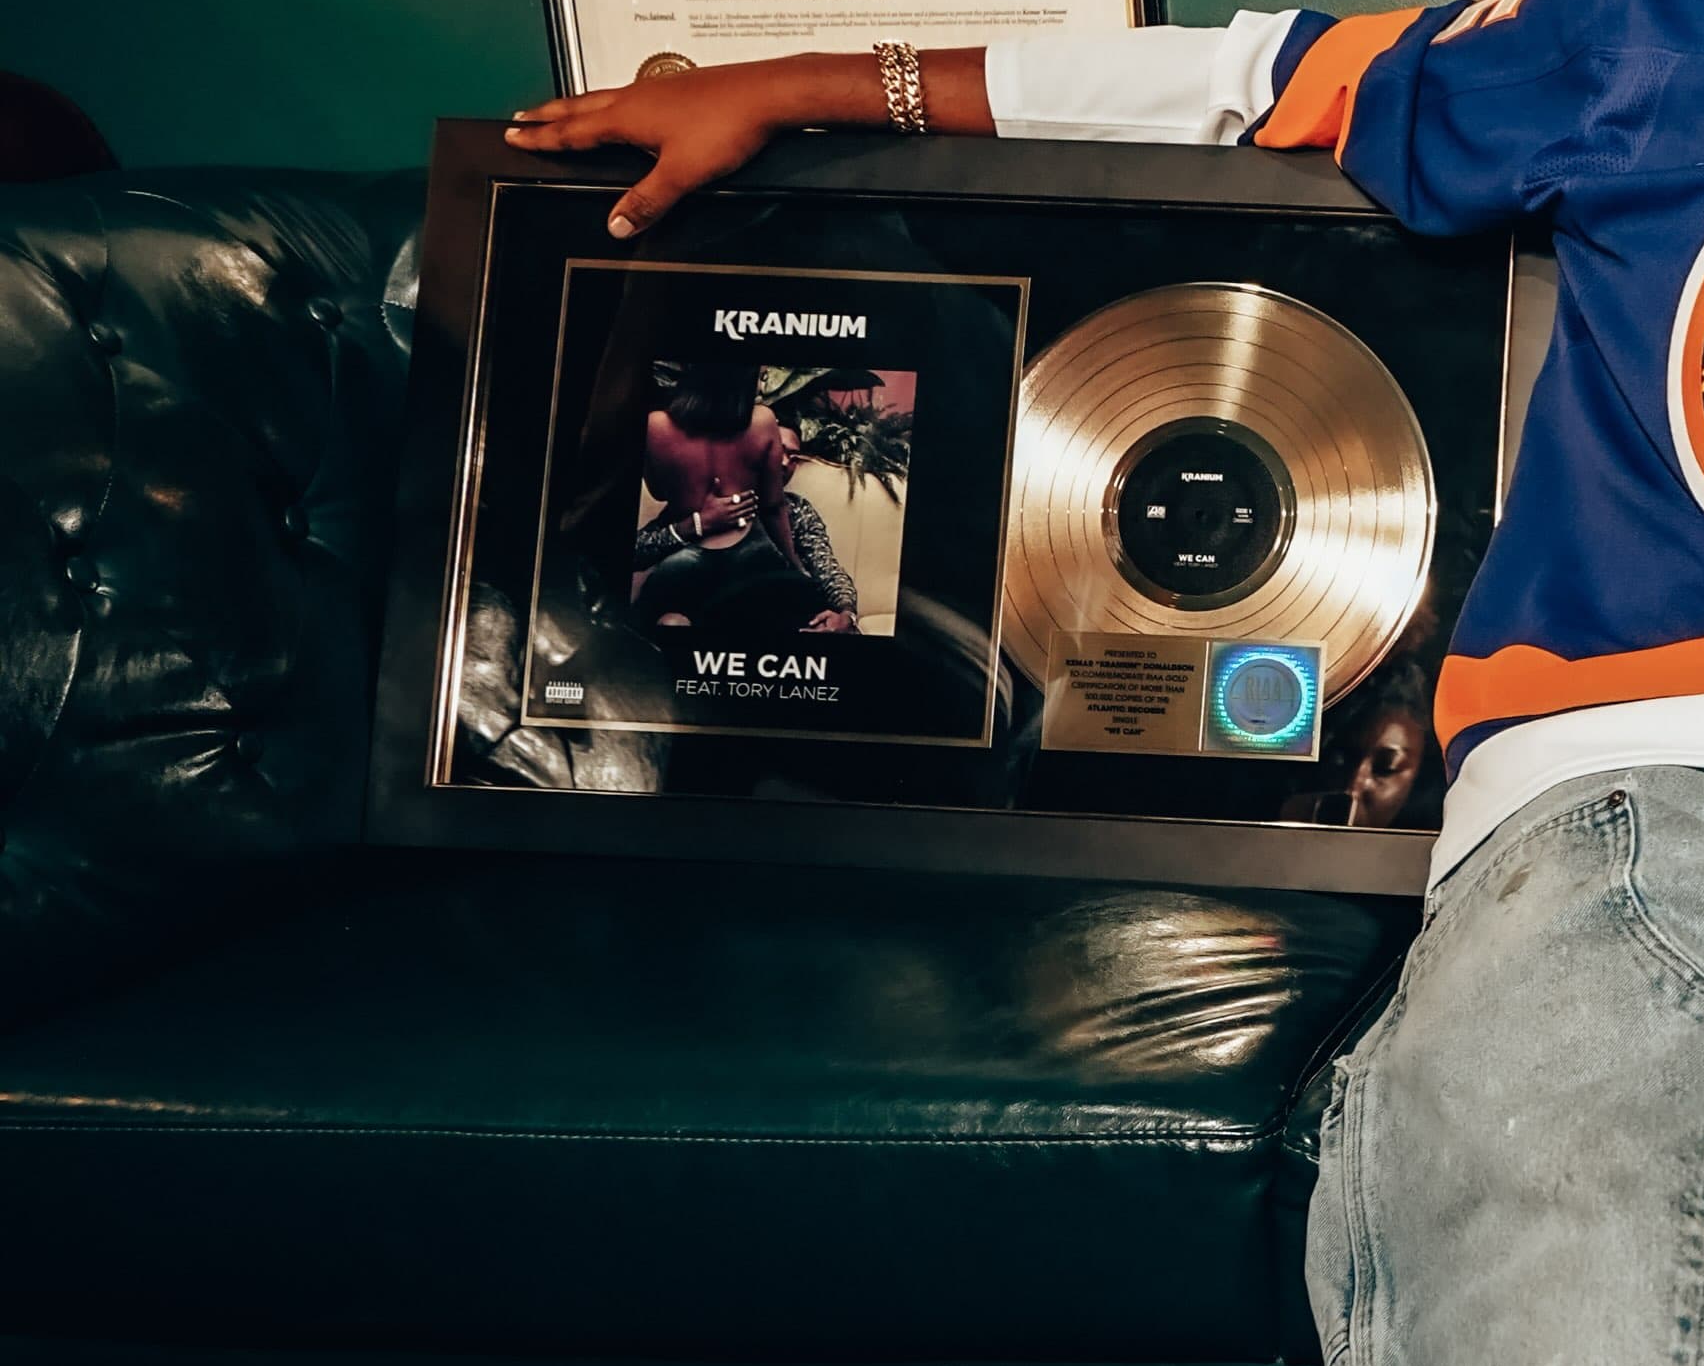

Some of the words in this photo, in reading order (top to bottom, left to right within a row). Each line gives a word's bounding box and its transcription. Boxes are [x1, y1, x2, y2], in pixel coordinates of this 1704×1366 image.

[714, 310, 867, 341] KRANIUM
[1181, 472, 1223, 483] KRANIUM
[1178, 554, 1193, 563] WE
[1195, 555, 1216, 563] CAN
[1104, 650, 1145, 658] PRESENTED
[694, 651, 746, 677] WE
[757, 654, 828, 681] CAN
[1143, 663, 1195, 672] DONALDSON
[1165, 674, 1188, 683] GOLD
[675, 679, 722, 698] FEAT.
[727, 681, 775, 701] TORY
[780, 683, 840, 702] LANEZ
[1071, 681, 1126, 691] CERTIFICATION
[1141, 684, 1162, 692] MORE
[1165, 685, 1185, 693] THAN
[1115, 694, 1142, 703] COPIES
[1088, 705, 1125, 713] ATLANTIC
